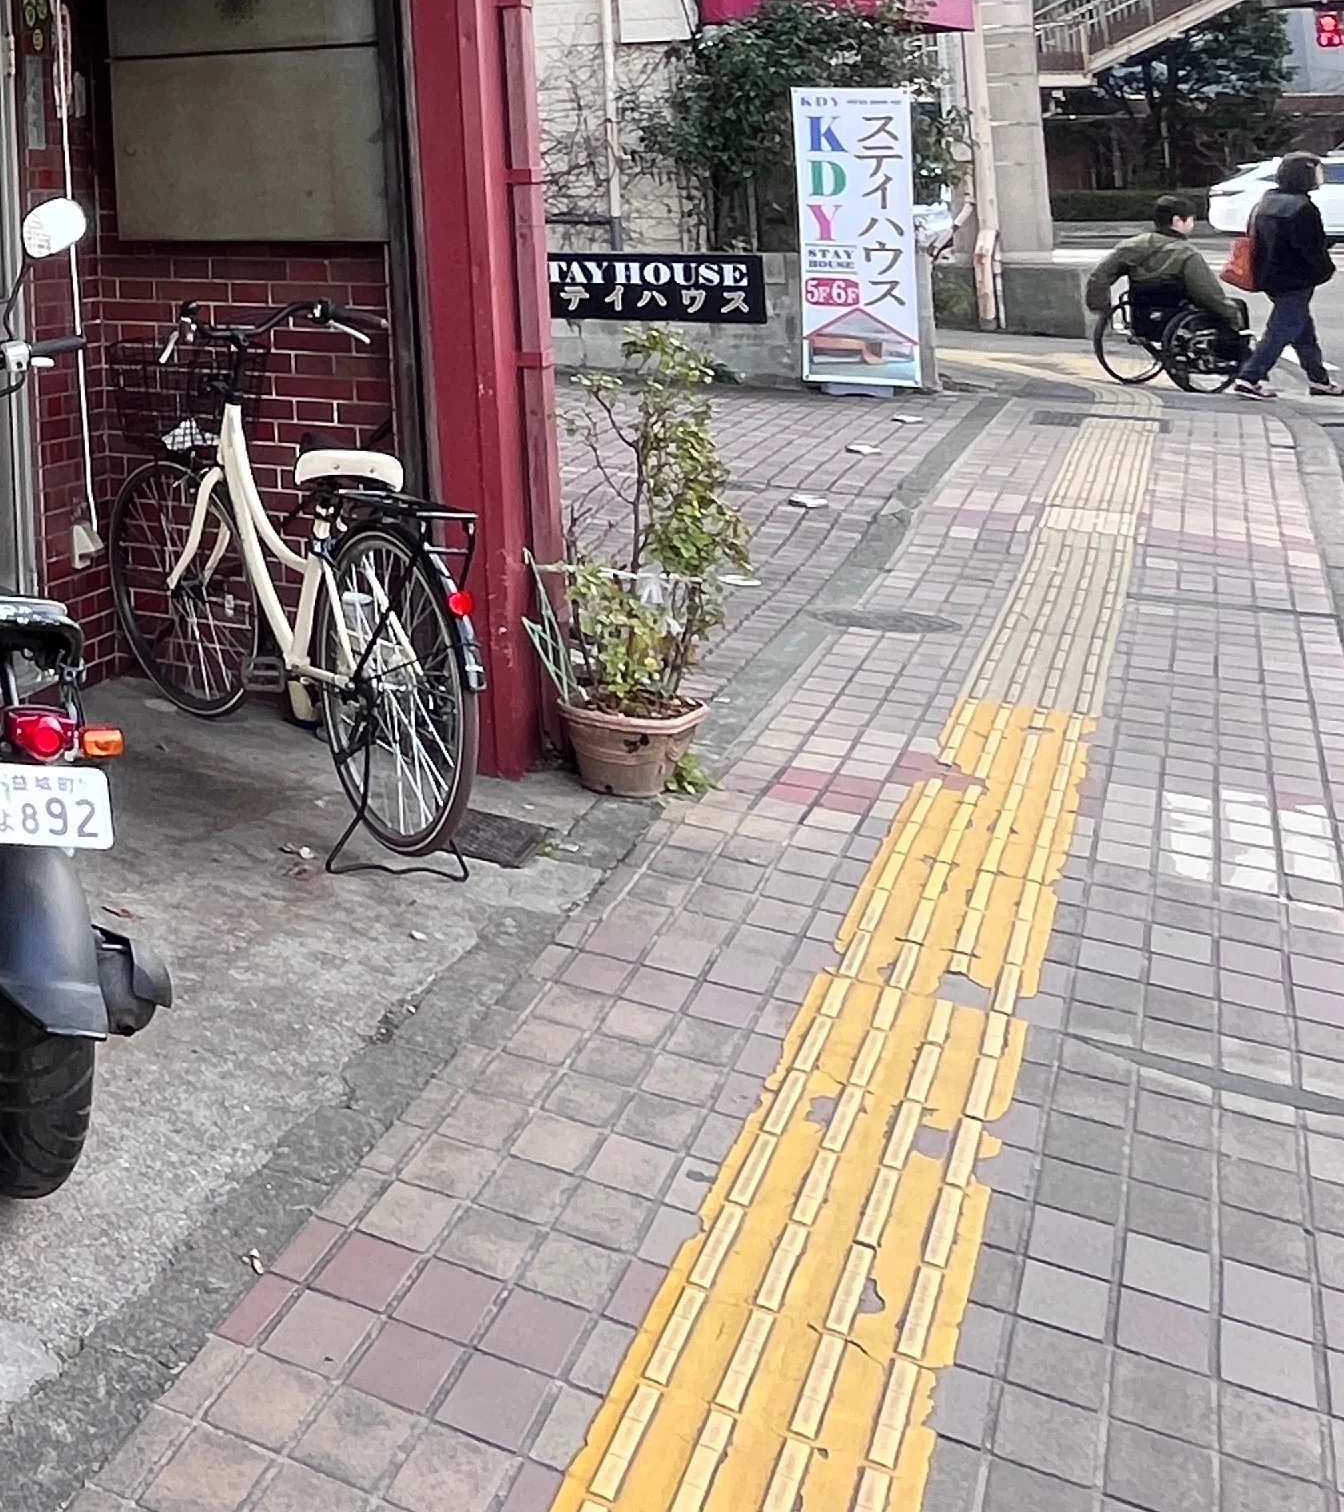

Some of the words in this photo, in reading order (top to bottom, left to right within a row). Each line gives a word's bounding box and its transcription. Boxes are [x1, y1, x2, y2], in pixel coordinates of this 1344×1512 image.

[853, 115, 906, 307] ステイハウス
[807, 248, 855, 260] STAY
[808, 259, 856, 270] HOUSE
[612, 261, 749, 287] HOUSE
[559, 285, 751, 314] テイハウス
